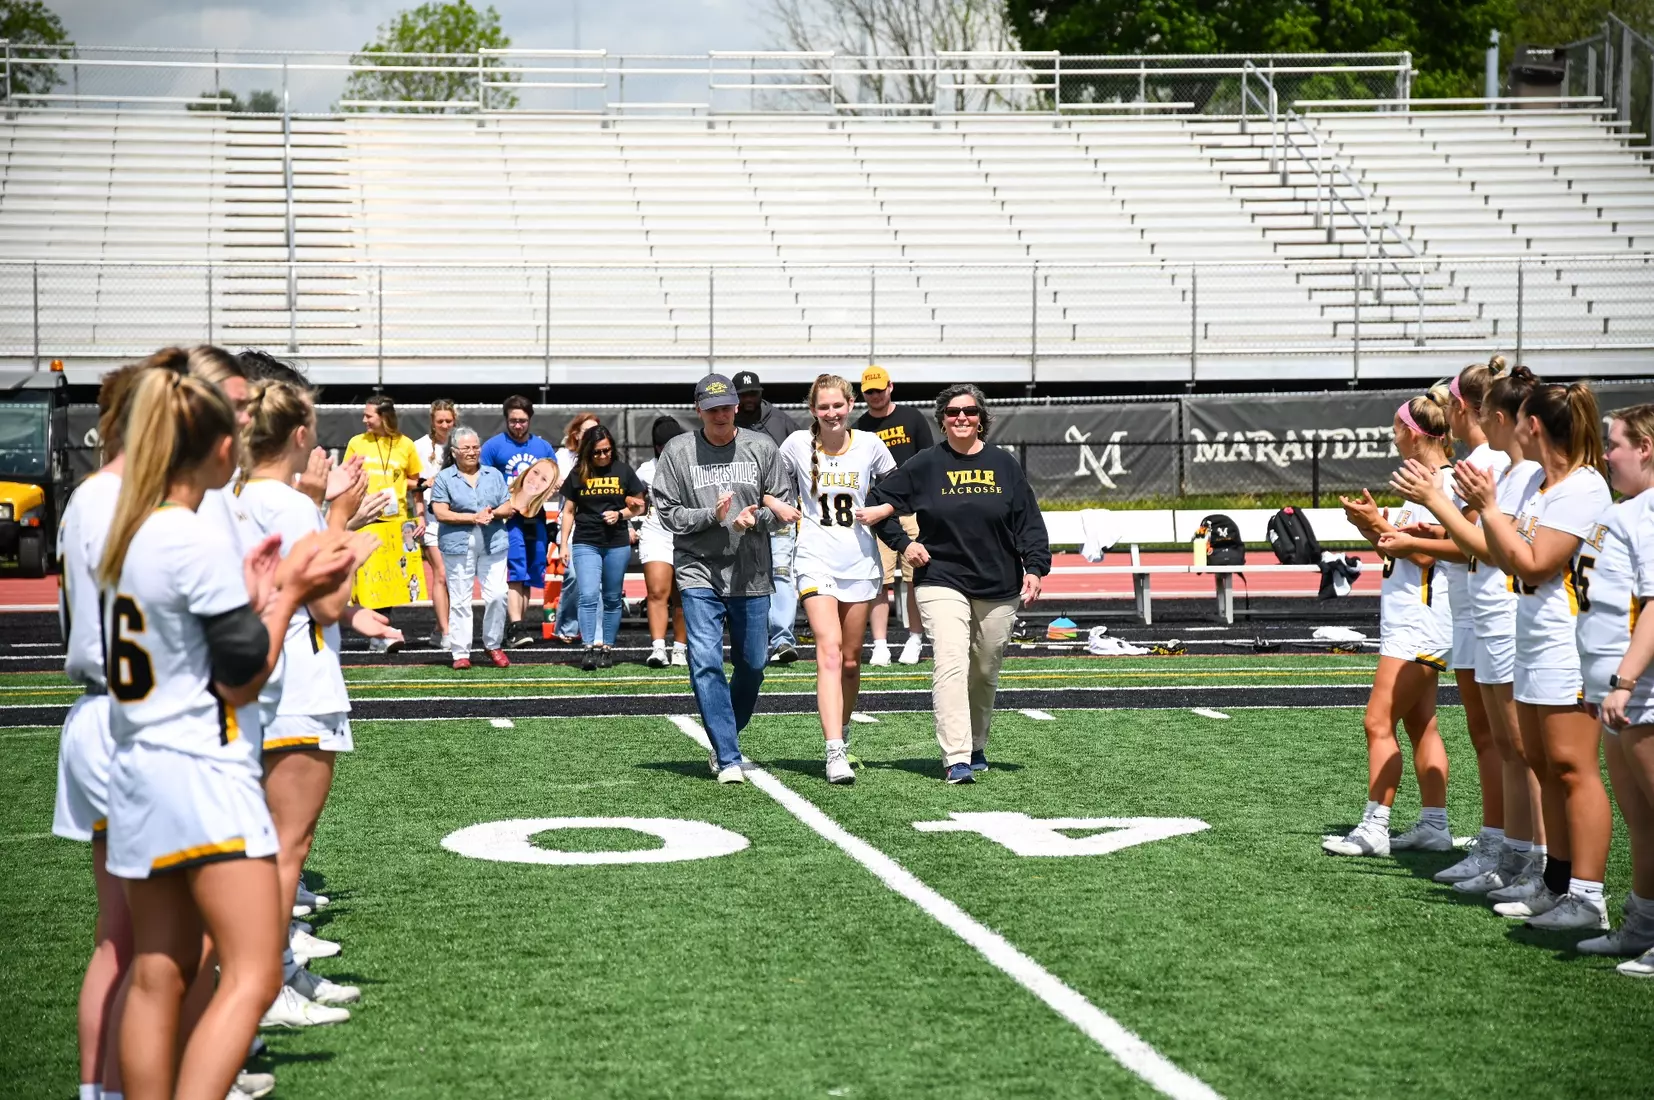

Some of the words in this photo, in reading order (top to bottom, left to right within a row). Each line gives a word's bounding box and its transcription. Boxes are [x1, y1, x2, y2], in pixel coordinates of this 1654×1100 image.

[586, 476, 620, 490] VILLE
[690, 461, 758, 490] MILLERSVILLE
[946, 469, 996, 487] VILLE
[580, 488, 625, 497] LACROSSE
[941, 486, 1002, 496] LACROSSE
[818, 493, 854, 528] 18
[108, 593, 156, 705] 6
